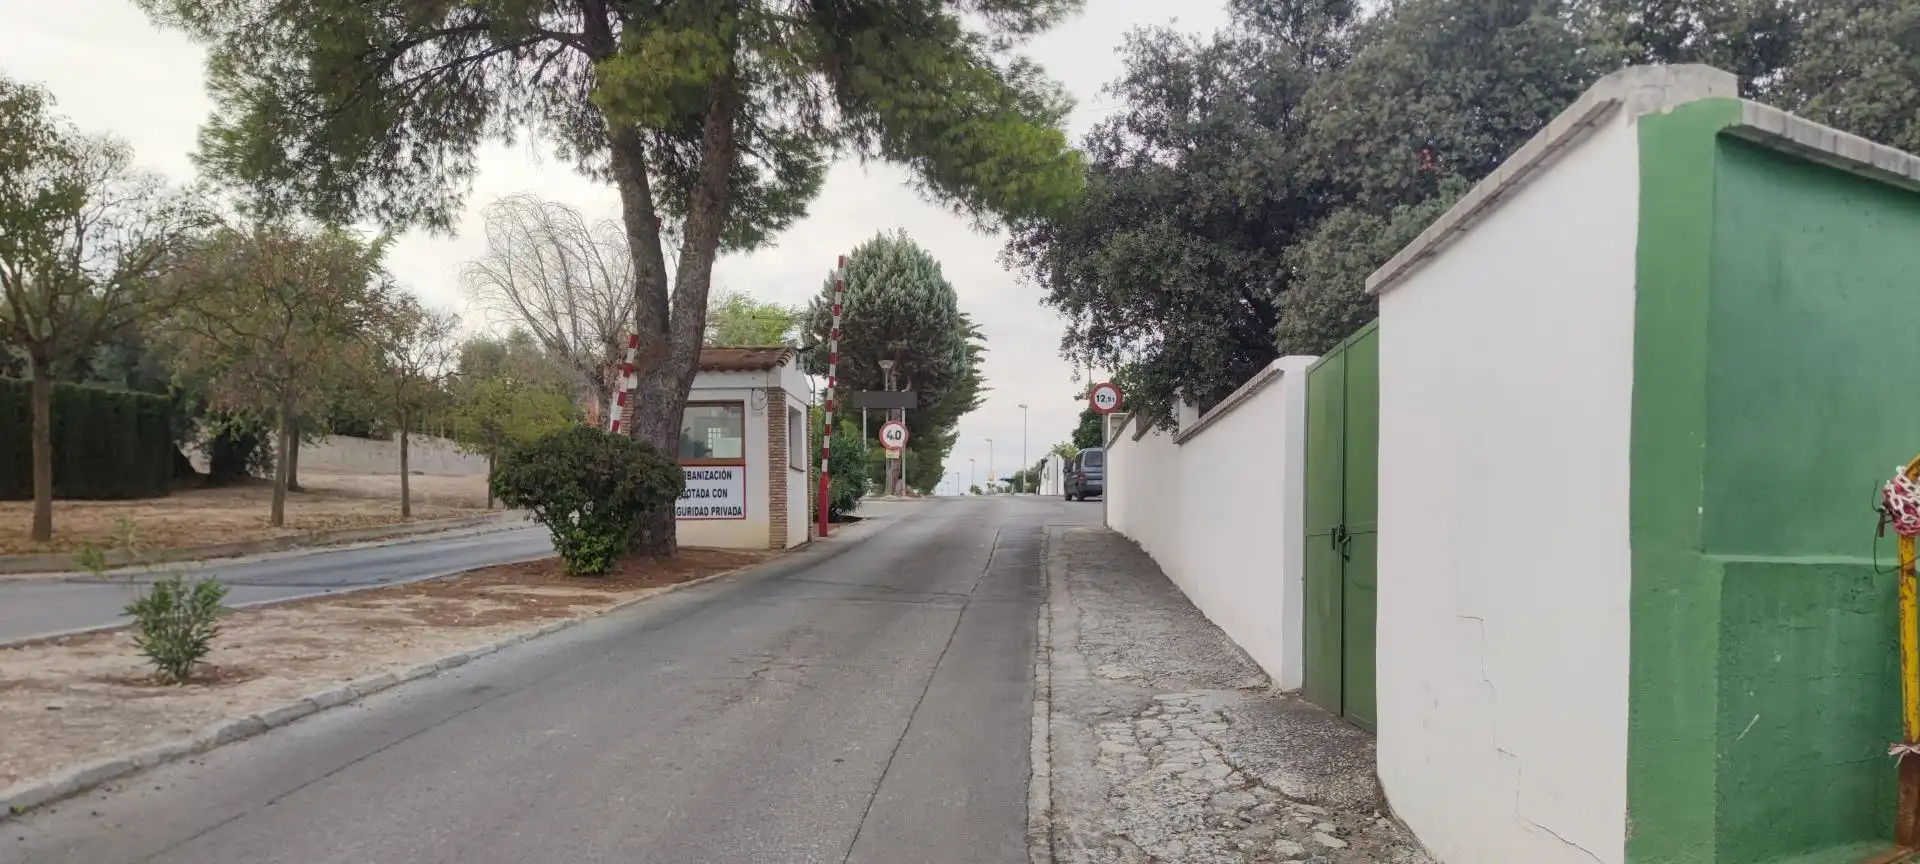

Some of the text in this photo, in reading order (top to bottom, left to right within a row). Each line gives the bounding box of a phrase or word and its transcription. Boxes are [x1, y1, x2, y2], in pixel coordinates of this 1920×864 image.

[886, 430, 902, 440] 40
[683, 468, 732, 480] RBANIZACIÓN
[712, 488, 728, 499] CON
[676, 506, 742, 517] GURIDAD PRIVADA
